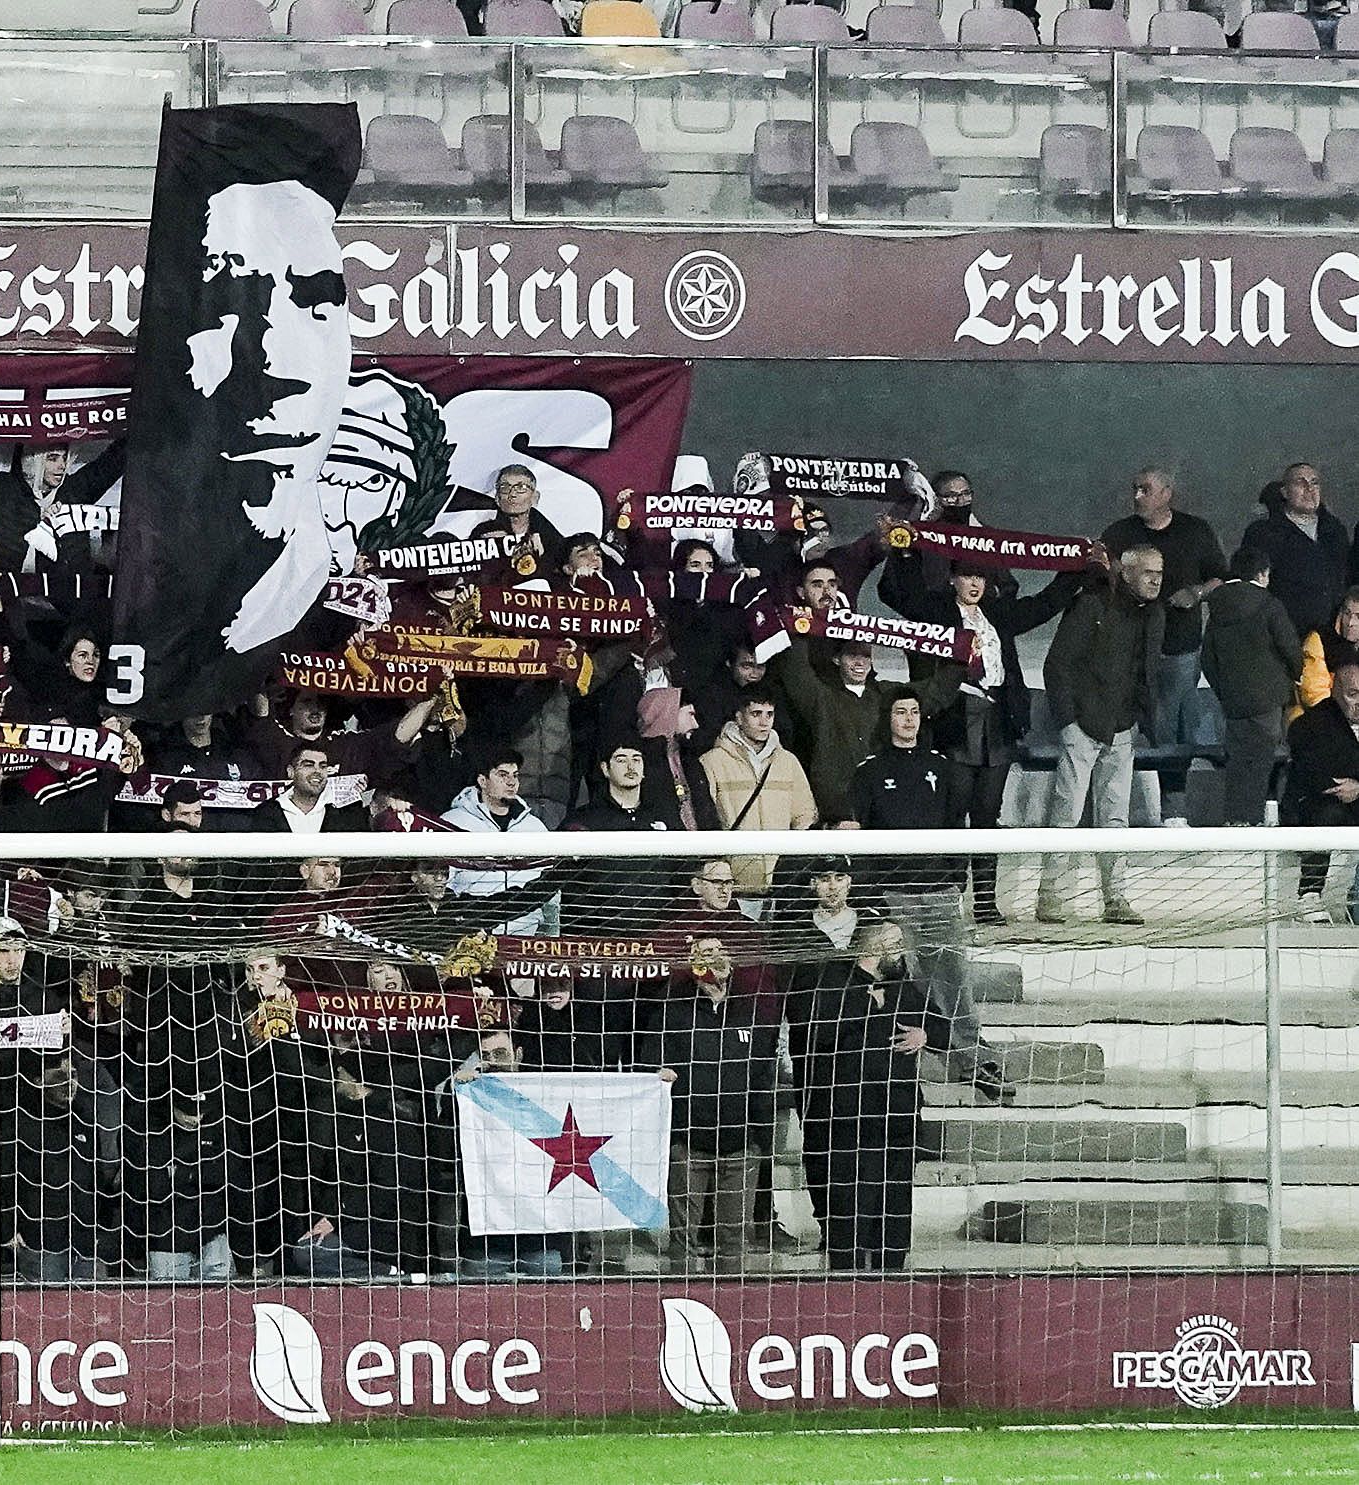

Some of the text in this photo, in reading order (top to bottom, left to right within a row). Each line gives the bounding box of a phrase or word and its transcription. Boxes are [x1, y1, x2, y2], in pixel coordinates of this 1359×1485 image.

[954, 250, 1292, 348] Estrella
[40, 411, 79, 429] QUE
[88, 407, 127, 423] ROE
[770, 456, 901, 479] PONTEVEDRA
[785, 476, 819, 490] Club
[645, 517, 673, 530] CLUB
[378, 537, 499, 568] PONTEVEDRA
[951, 536, 996, 552] PARAR
[1000, 541, 1026, 555] ATA
[1031, 544, 1082, 557] VOLTAR
[427, 565, 482, 576] DESDE 1941
[503, 591, 631, 613] PONTEVEDRA
[490, 610, 551, 631] NUNCA
[559, 617, 581, 632] SE
[590, 618, 642, 634] RINDE
[825, 627, 852, 640] CLUB
[106, 644, 145, 704] 3
[488, 662, 515, 674] BOA
[519, 662, 548, 675] VILA
[283, 668, 428, 693] PONTEVEDRA
[521, 940, 655, 956] PONTEVEDRA
[505, 961, 671, 978] NUNCA SE RINDE
[321, 995, 447, 1011] PONTEVEDRA
[308, 1014, 460, 1031] NUNCA SE RINDE
[1175, 1314, 1239, 1337] CONSERVAS
[344, 1338, 540, 1405] ence
[746, 1331, 939, 1400] ence
[1113, 1350, 1317, 1388] PESCAMAR
